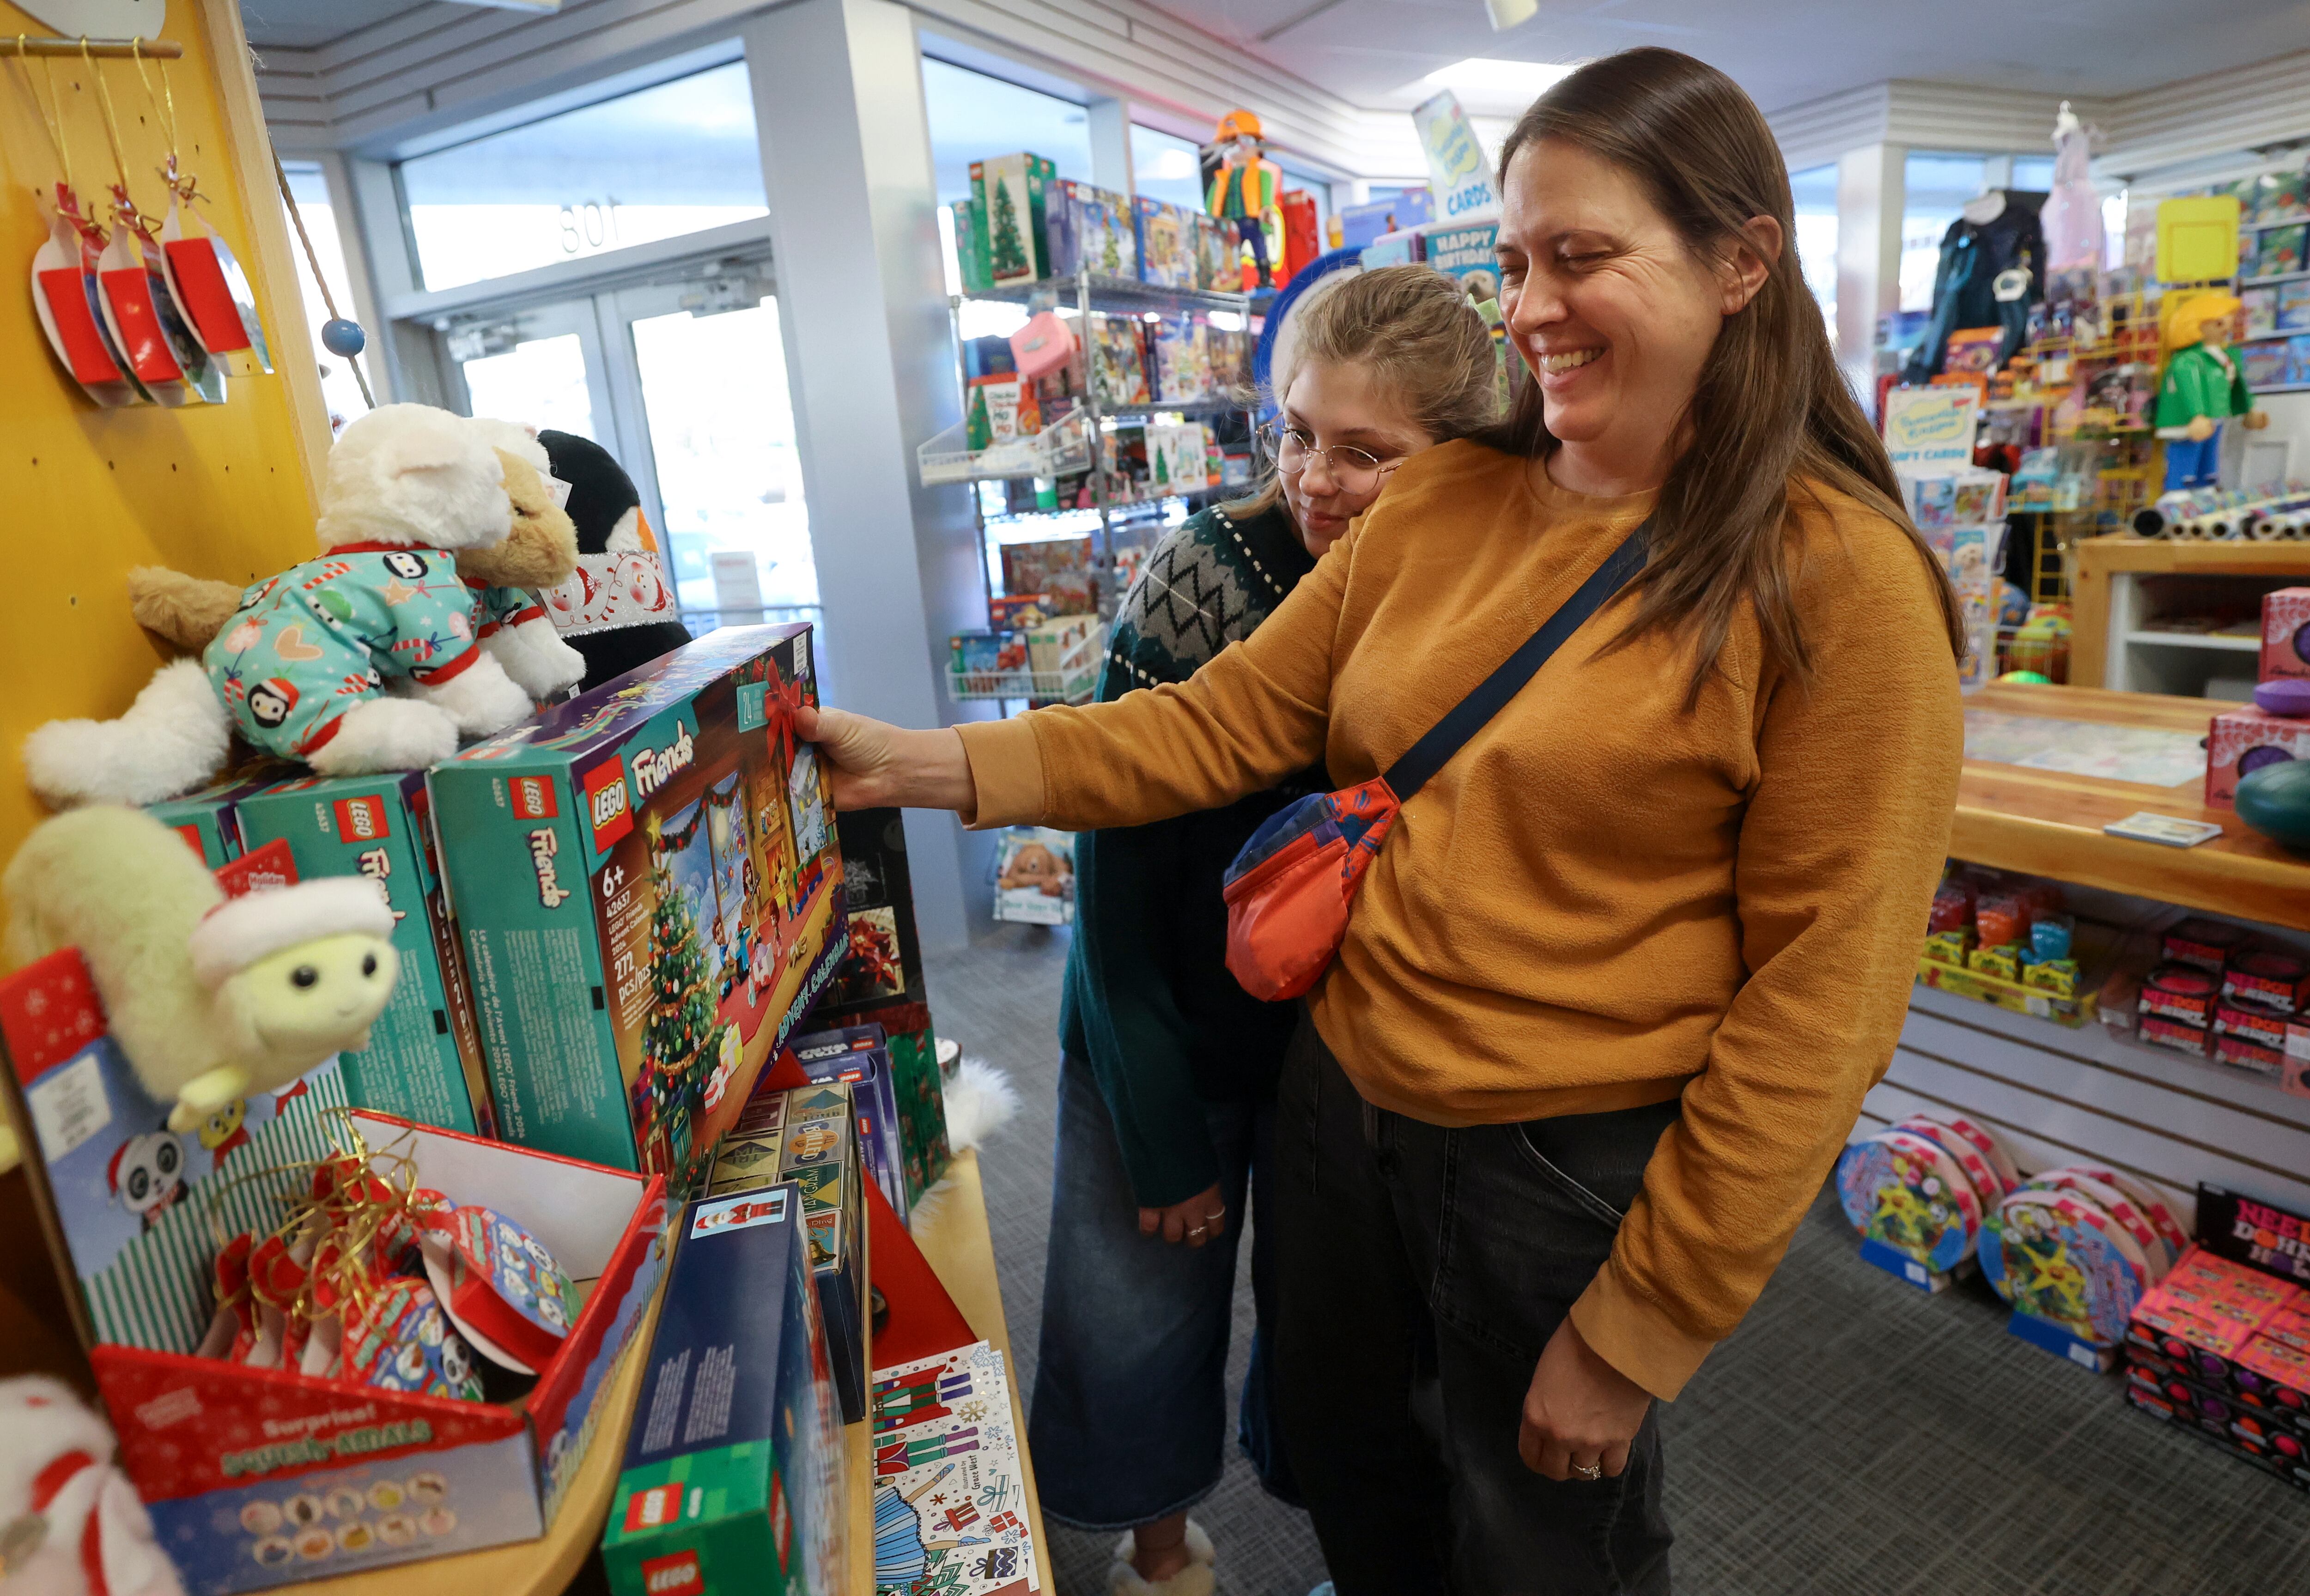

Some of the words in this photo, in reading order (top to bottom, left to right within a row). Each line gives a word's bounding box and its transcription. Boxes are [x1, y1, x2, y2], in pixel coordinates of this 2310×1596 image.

[1448, 182, 1491, 215] CARDS
[1436, 230, 1492, 252] HAPPY
[1924, 449, 1966, 460] CARDS
[743, 692, 752, 724] 24
[631, 719, 693, 797] Friends
[523, 780, 543, 815] LEGO
[594, 780, 625, 826] LEGO
[349, 802, 373, 836] LEGO
[531, 827, 570, 907] Friends
[603, 865, 624, 898] 6+
[606, 890, 630, 918] 42637
[626, 902, 643, 921] Friends
[479, 930, 486, 941] Le
[611, 926, 630, 946] Advent
[630, 908, 650, 929] Calendar
[469, 929, 485, 983] Calendario
[612, 941, 626, 956] 2024
[482, 944, 496, 993] calendrier
[615, 951, 634, 982] 272
[480, 985, 488, 997] de
[619, 963, 651, 1006] pcs/pzs
[778, 984, 809, 1044] ADVENT
[811, 932, 849, 994] CALENDAR
[492, 995, 501, 1008] de
[483, 1001, 496, 1043] Adviento
[495, 1011, 507, 1044] l'Avent
[492, 1046, 502, 1069] 2024
[508, 1079, 521, 1113] Friends
[504, 1104, 515, 1136] Friends
[515, 1115, 525, 1138] 2024
[795, 1140, 805, 1148] UP
[801, 1126, 822, 1160] BALLED
[825, 1135, 834, 1144] ALL
[804, 1168, 819, 1212] TANGRAM
[812, 1217, 833, 1226] Ding
[263, 1402, 376, 1437] Surprise!
[968, 1455, 978, 1470] West
[972, 1471, 981, 1490] Grace
